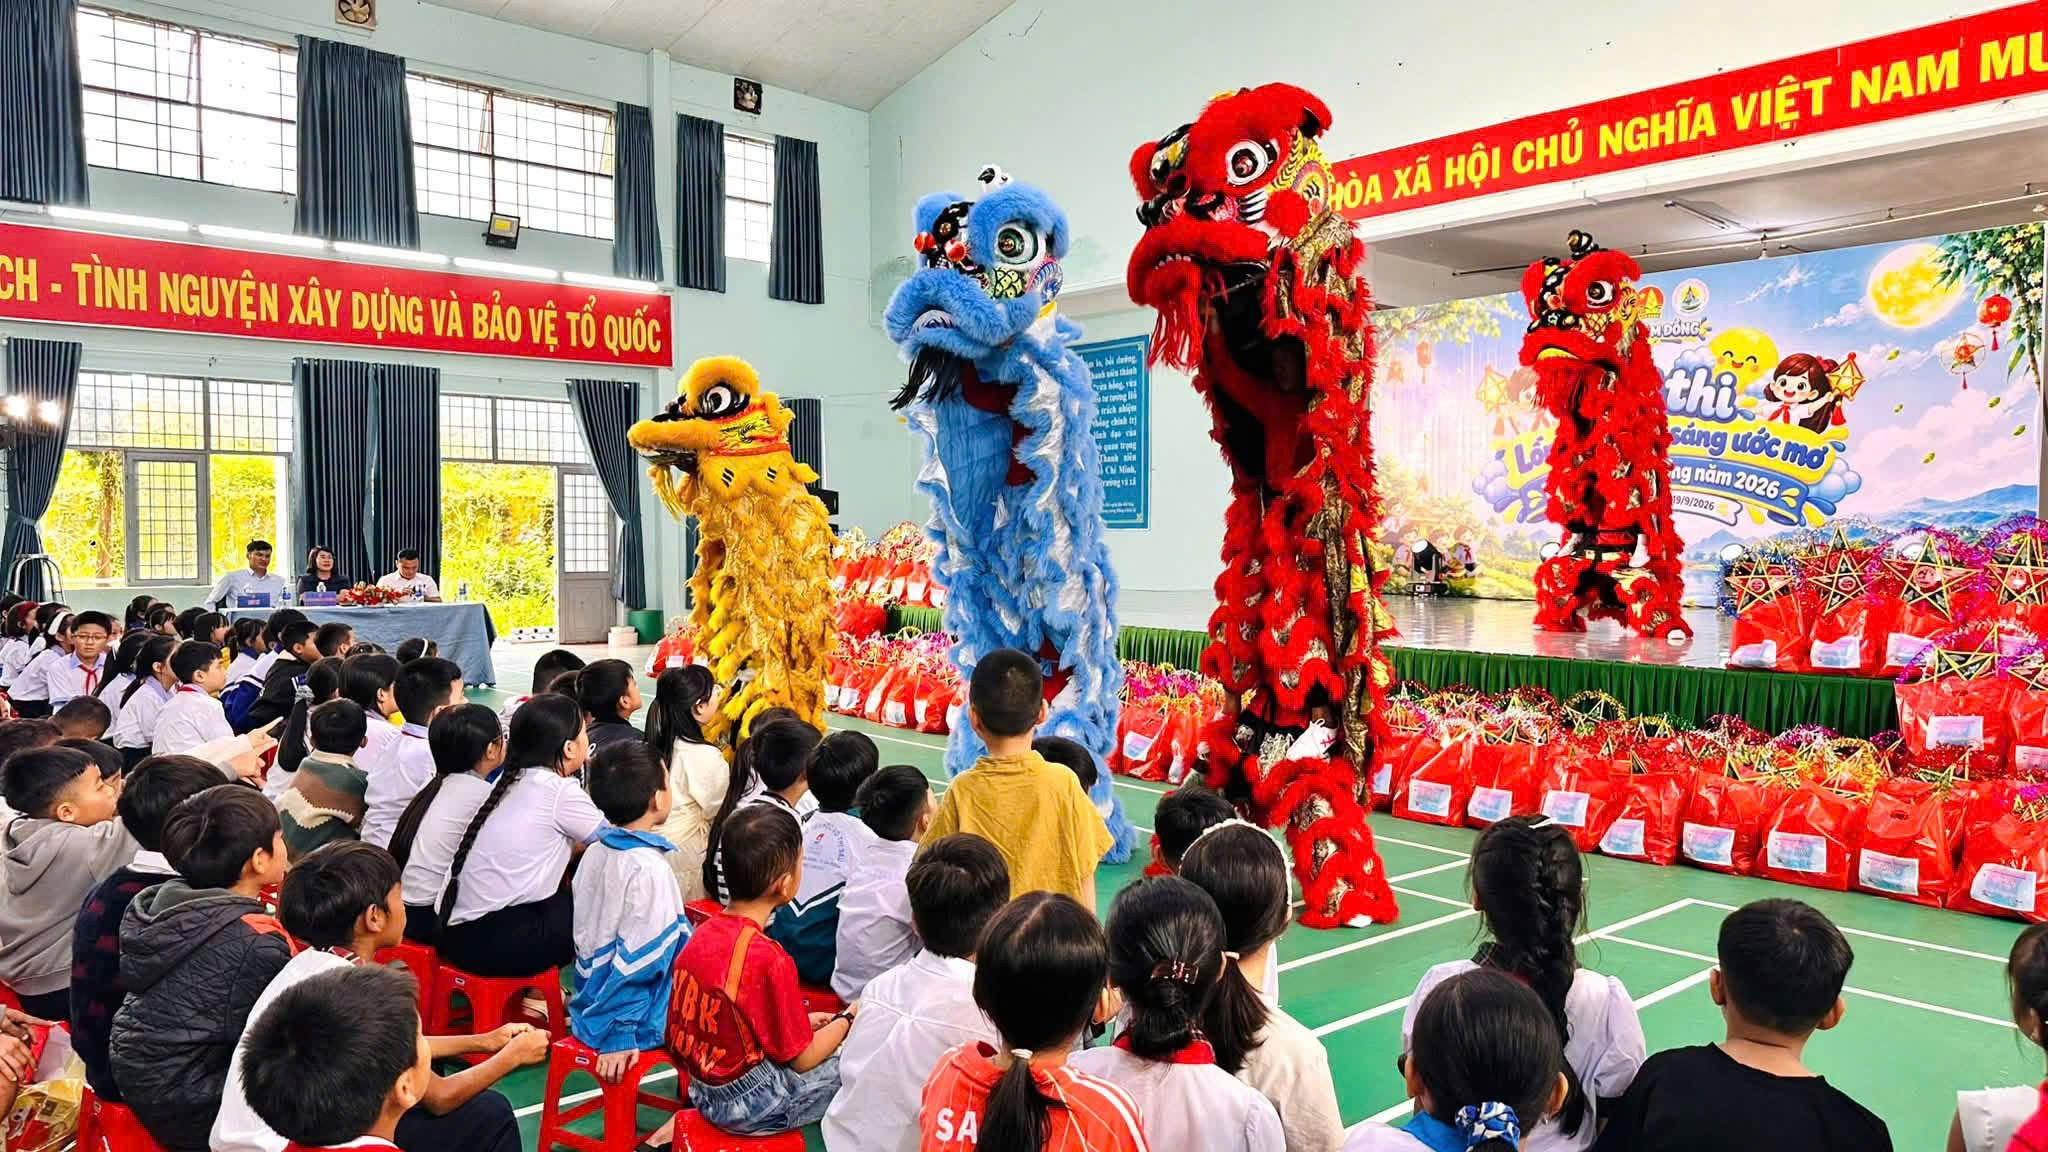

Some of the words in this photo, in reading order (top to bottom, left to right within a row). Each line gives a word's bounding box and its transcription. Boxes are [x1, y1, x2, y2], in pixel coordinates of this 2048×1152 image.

[1328, 171, 1383, 211] HÒA
[1391, 155, 1432, 200] XÃ
[1444, 142, 1500, 190] HỘI
[1512, 117, 1584, 174] CHỦ
[1599, 98, 1717, 158] NGHĨA
[1730, 75, 1833, 131] VIỆT
[1851, 49, 1959, 109] NAM
[71, 254, 147, 312] TÌNH
[159, 269, 278, 329] NGUYỆN
[288, 276, 342, 328] XÂY
[351, 287, 424, 340] DỰNG
[430, 289, 464, 338] VÀ
[472, 289, 522, 343] BẢO
[528, 300, 558, 352] VỆ
[566, 295, 597, 349] TỔ
[603, 304, 661, 357] QUỐC
[1664, 366, 1736, 422] thi
[1670, 422, 1728, 457] sáng
[1731, 427, 1782, 458] ước
[1781, 440, 1830, 470] mơ
[1694, 463, 1733, 487] năm
[1733, 471, 1782, 499] 2026
[935, 1106, 978, 1145] SA
